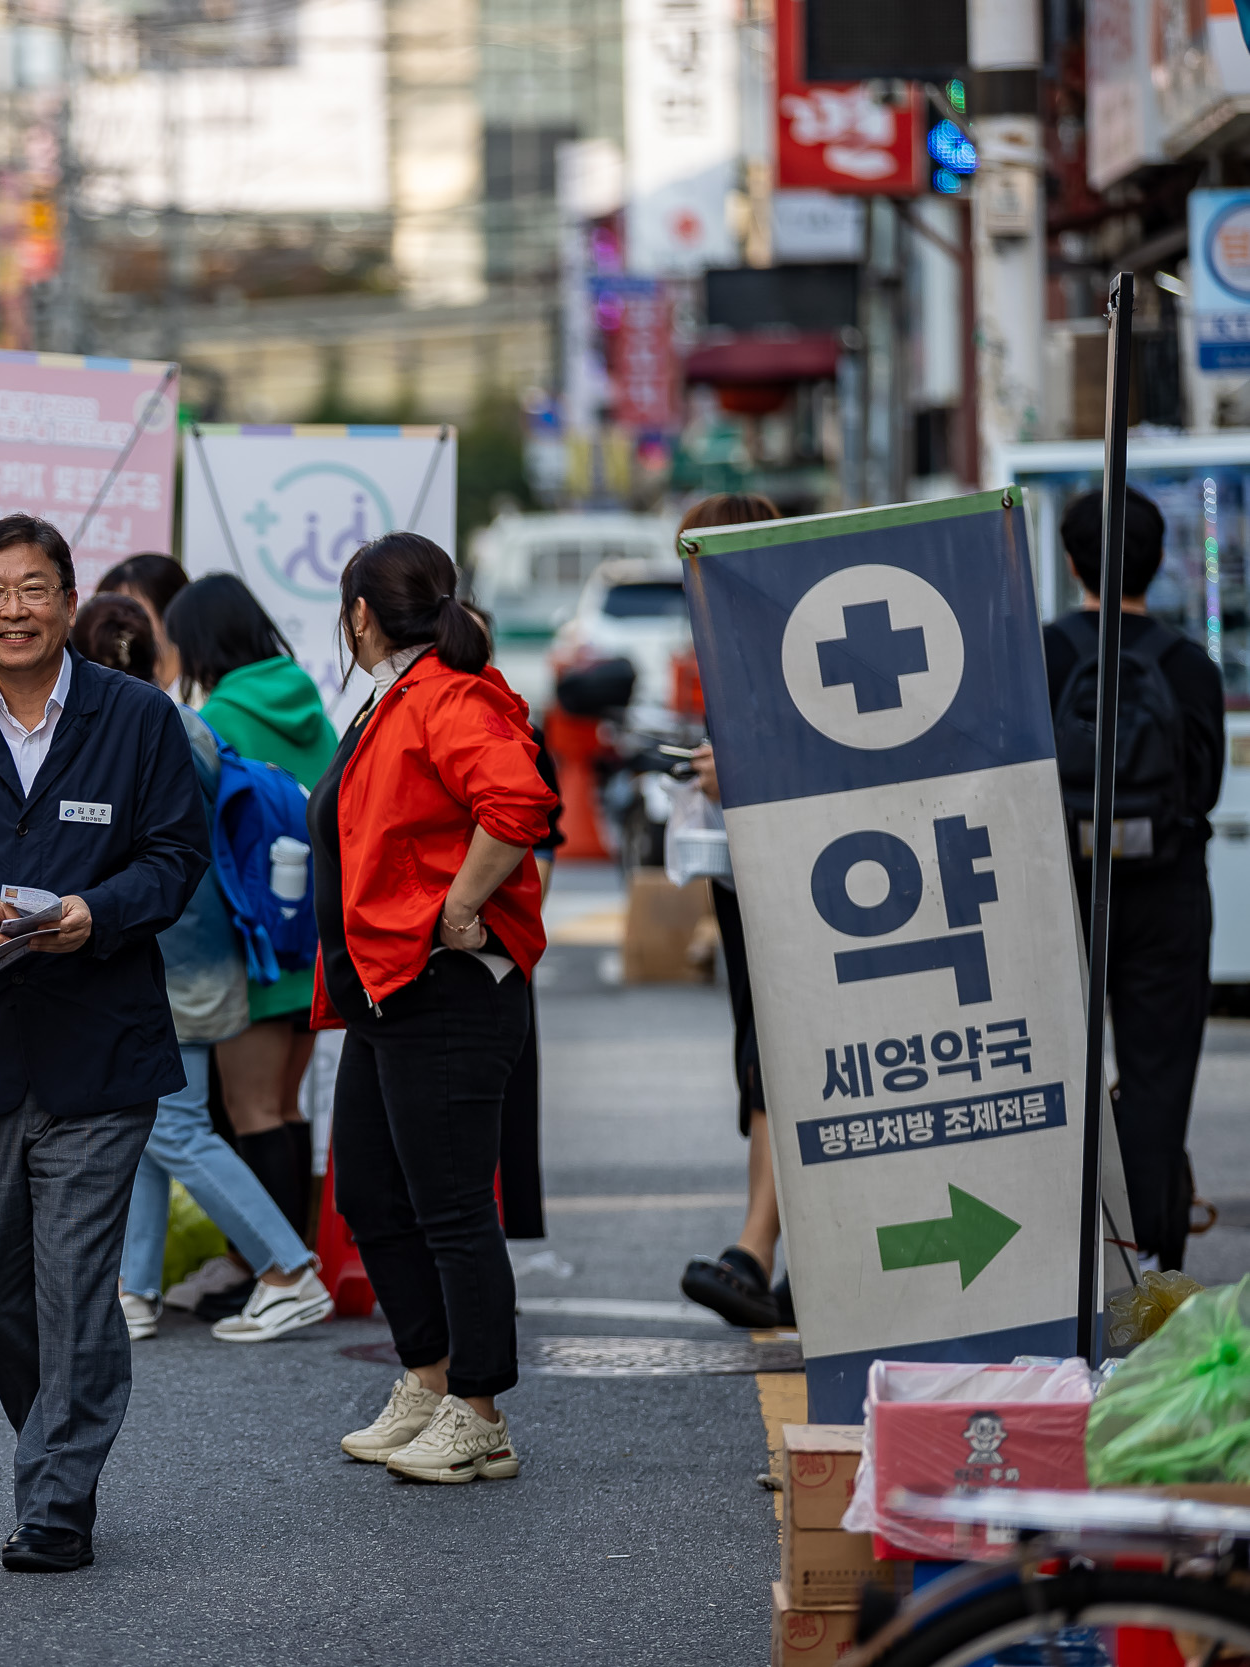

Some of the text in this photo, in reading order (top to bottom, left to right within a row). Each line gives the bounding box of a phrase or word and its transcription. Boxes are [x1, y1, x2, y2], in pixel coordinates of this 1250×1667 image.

[811, 814, 999, 1006] 약
[822, 1017, 1033, 1101] 세영약국
[818, 1092, 1048, 1156] 병원처방 조제전문
